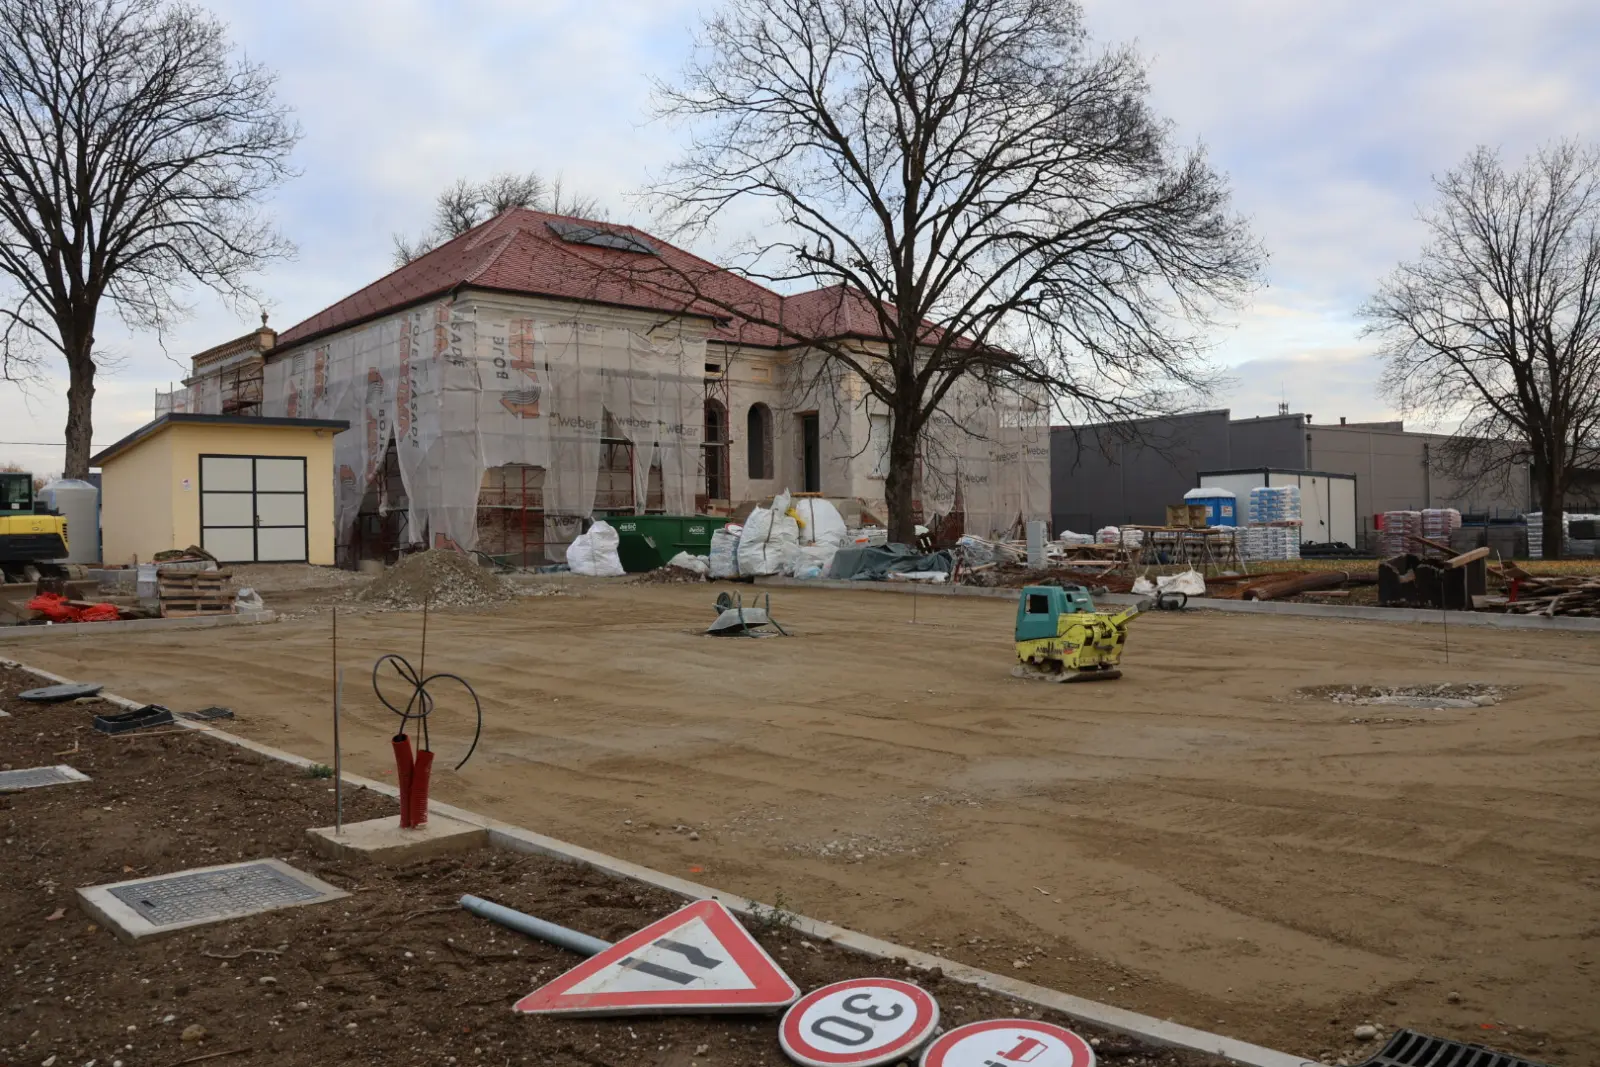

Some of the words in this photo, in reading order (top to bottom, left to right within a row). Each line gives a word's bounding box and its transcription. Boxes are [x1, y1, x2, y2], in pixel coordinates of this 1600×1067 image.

[492, 336, 509, 380] BOJE
[410, 380, 420, 449] FASADE
[616, 414, 652, 429] weber
[558, 415, 599, 430] weber
[666, 423, 699, 437] weber
[995, 451, 1019, 462] weber
[964, 473, 988, 483] weber
[811, 993, 904, 1046] 30
